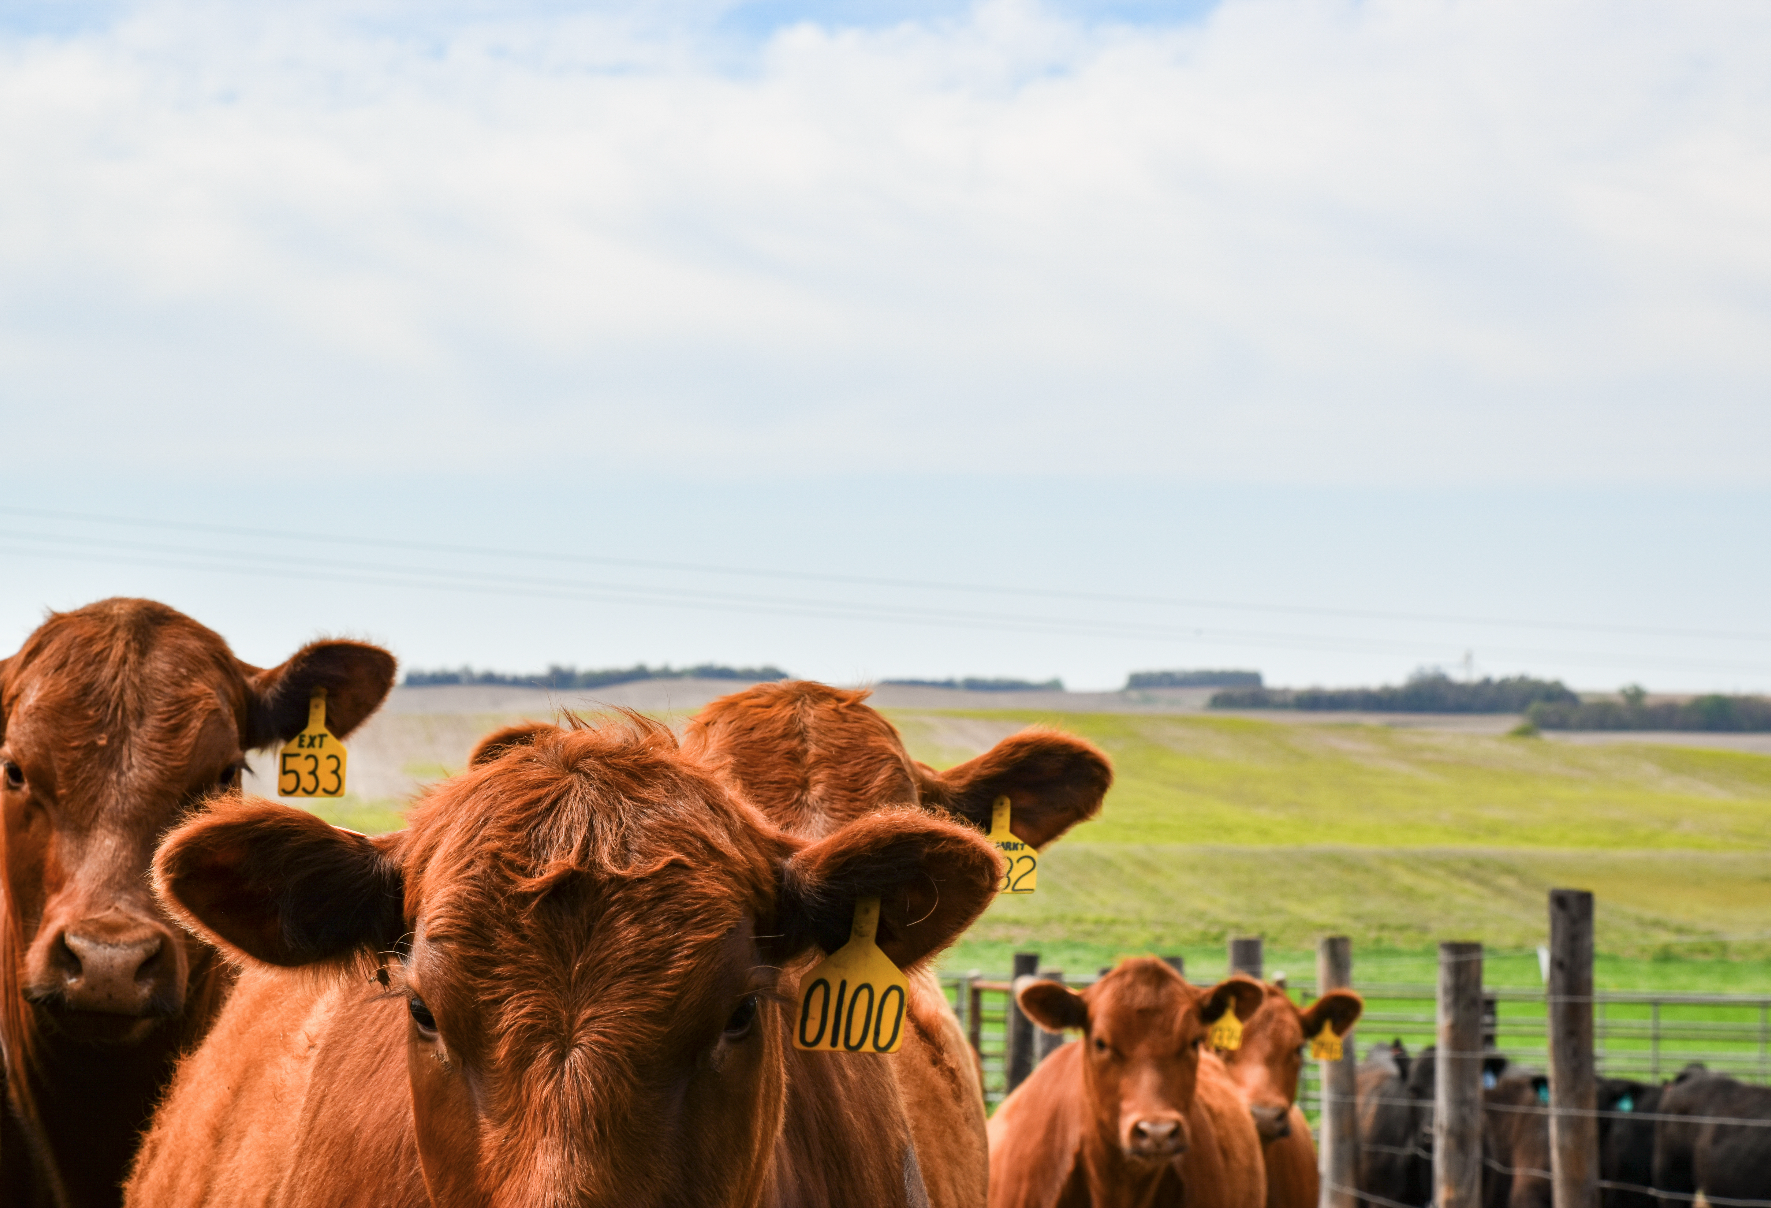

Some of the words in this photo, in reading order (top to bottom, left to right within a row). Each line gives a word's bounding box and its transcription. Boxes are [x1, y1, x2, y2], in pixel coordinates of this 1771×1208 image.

[298, 733, 328, 749] EXT
[281, 753, 342, 795] 533
[799, 978, 905, 1053] 0100
